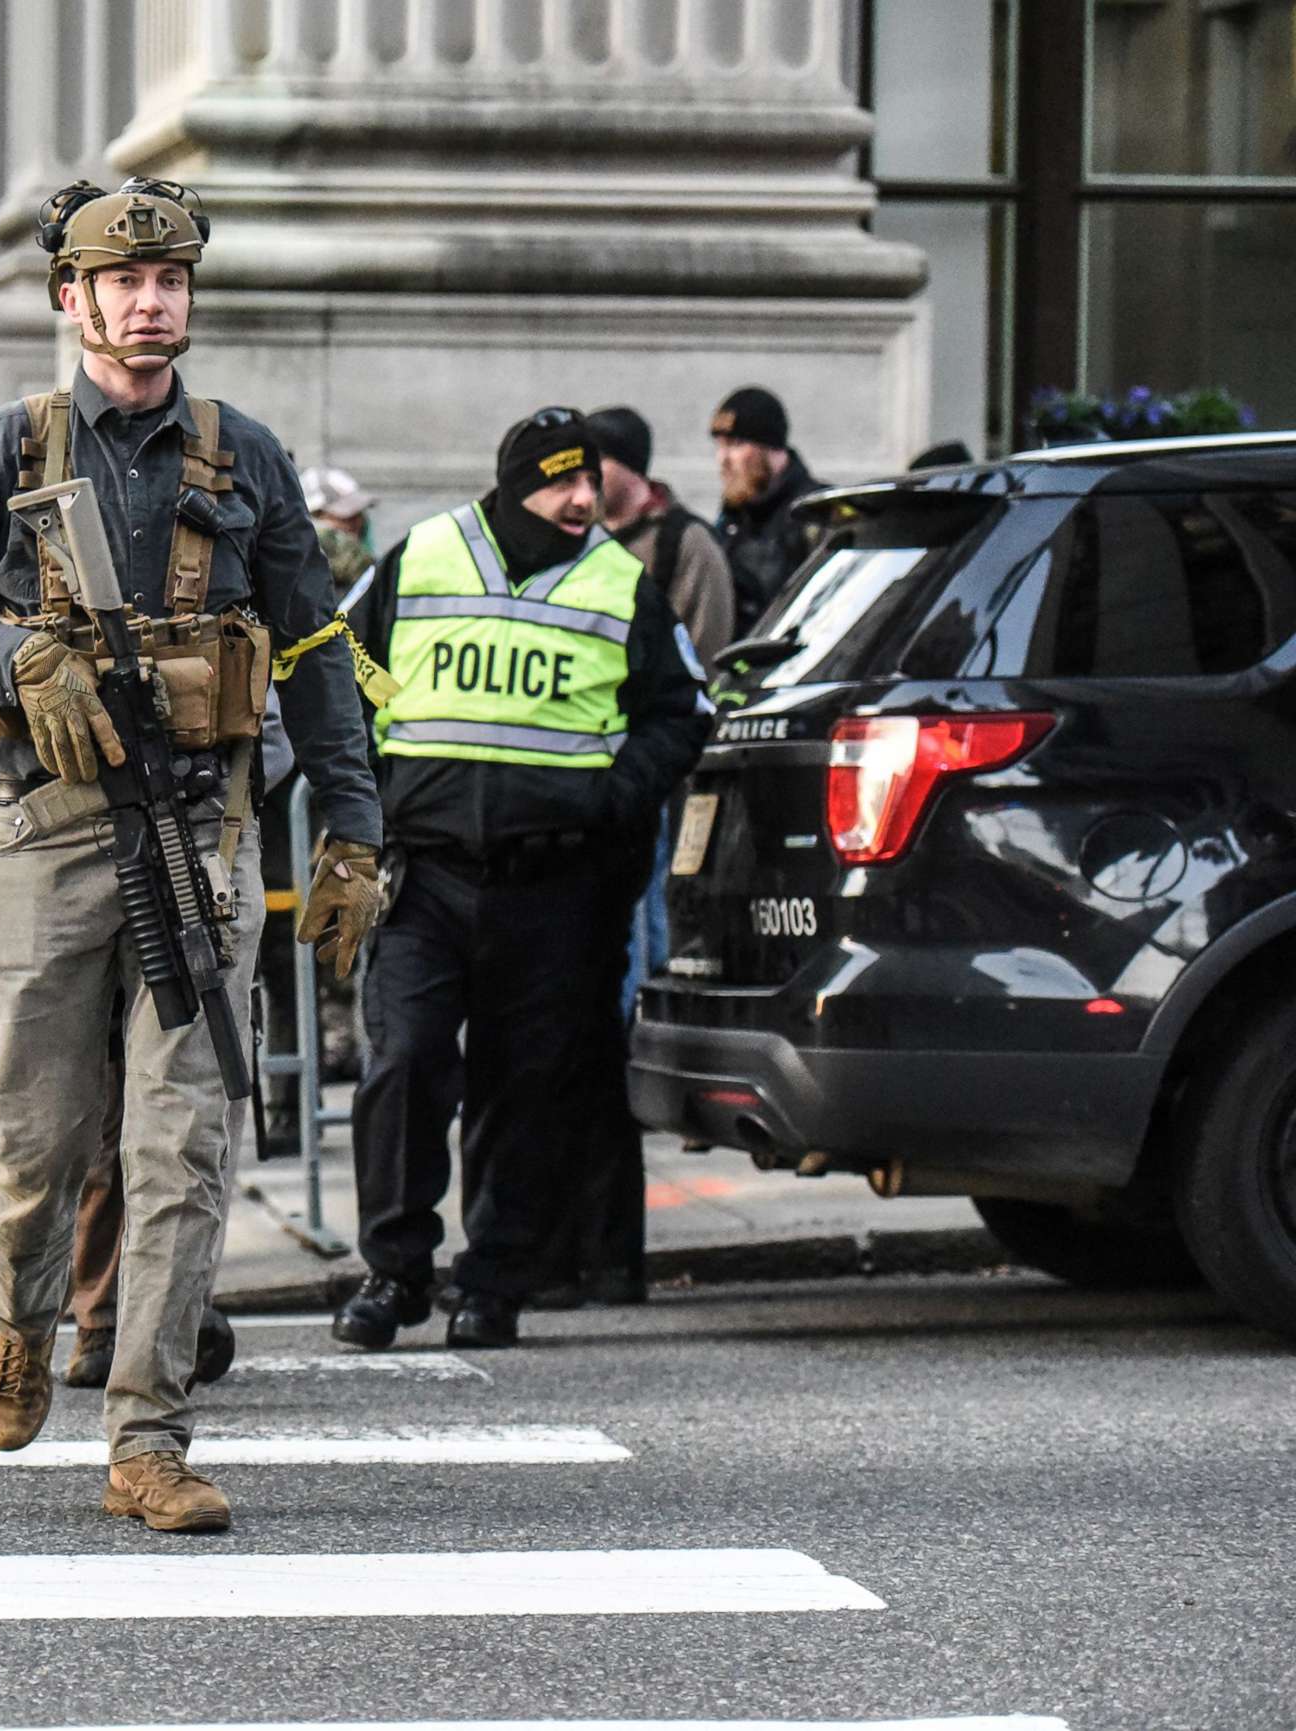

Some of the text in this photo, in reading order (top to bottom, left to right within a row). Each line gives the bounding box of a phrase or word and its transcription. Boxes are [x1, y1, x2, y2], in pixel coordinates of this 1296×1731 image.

[432, 641, 575, 702] POLICE
[716, 719, 789, 741] POLICE
[749, 897, 817, 936] 160103
